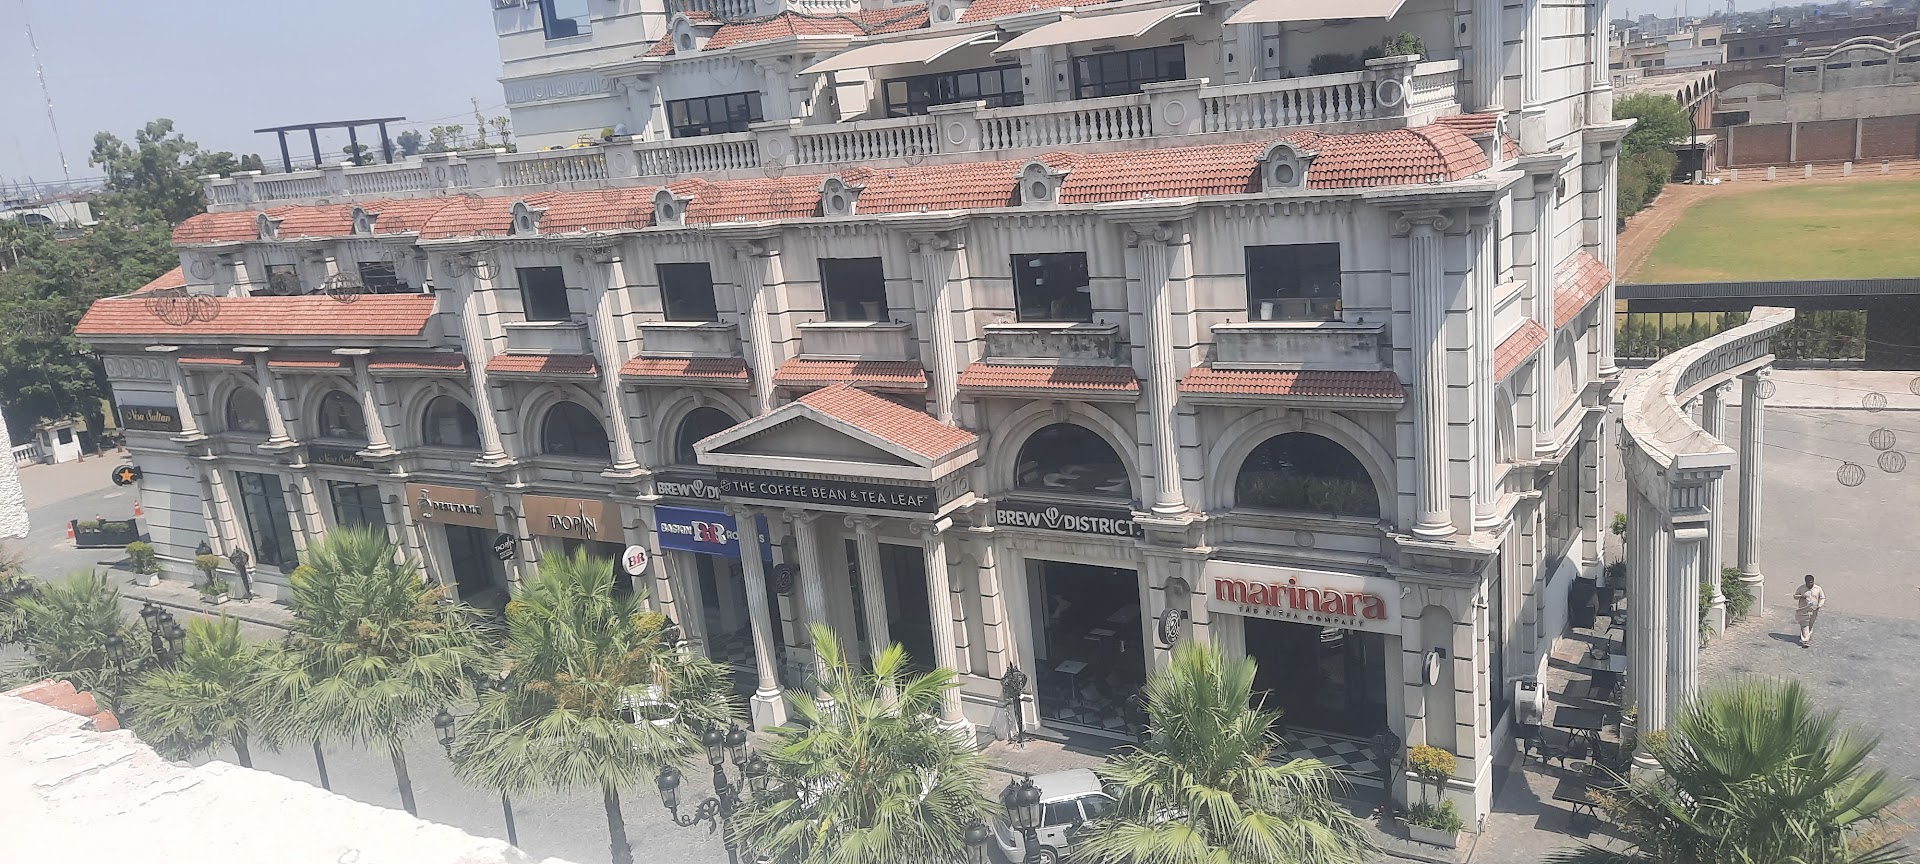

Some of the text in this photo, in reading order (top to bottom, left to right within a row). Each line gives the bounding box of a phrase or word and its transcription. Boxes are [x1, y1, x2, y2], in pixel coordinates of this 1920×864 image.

[126, 408, 171, 423] Nisa Sultan
[656, 481, 690, 498] BREW
[732, 481, 756, 494] THE
[759, 482, 808, 498] COFFEE
[811, 487, 847, 501] BEAN
[850, 489, 858, 499] &
[860, 490, 887, 504] TEA
[996, 509, 1041, 527] BREW
[660, 522, 692, 535] BASKIN
[691, 520, 727, 545] BR
[627, 552, 646, 569] BR
[1213, 575, 1388, 621] marinara
[1307, 614, 1365, 628] COMPANY
